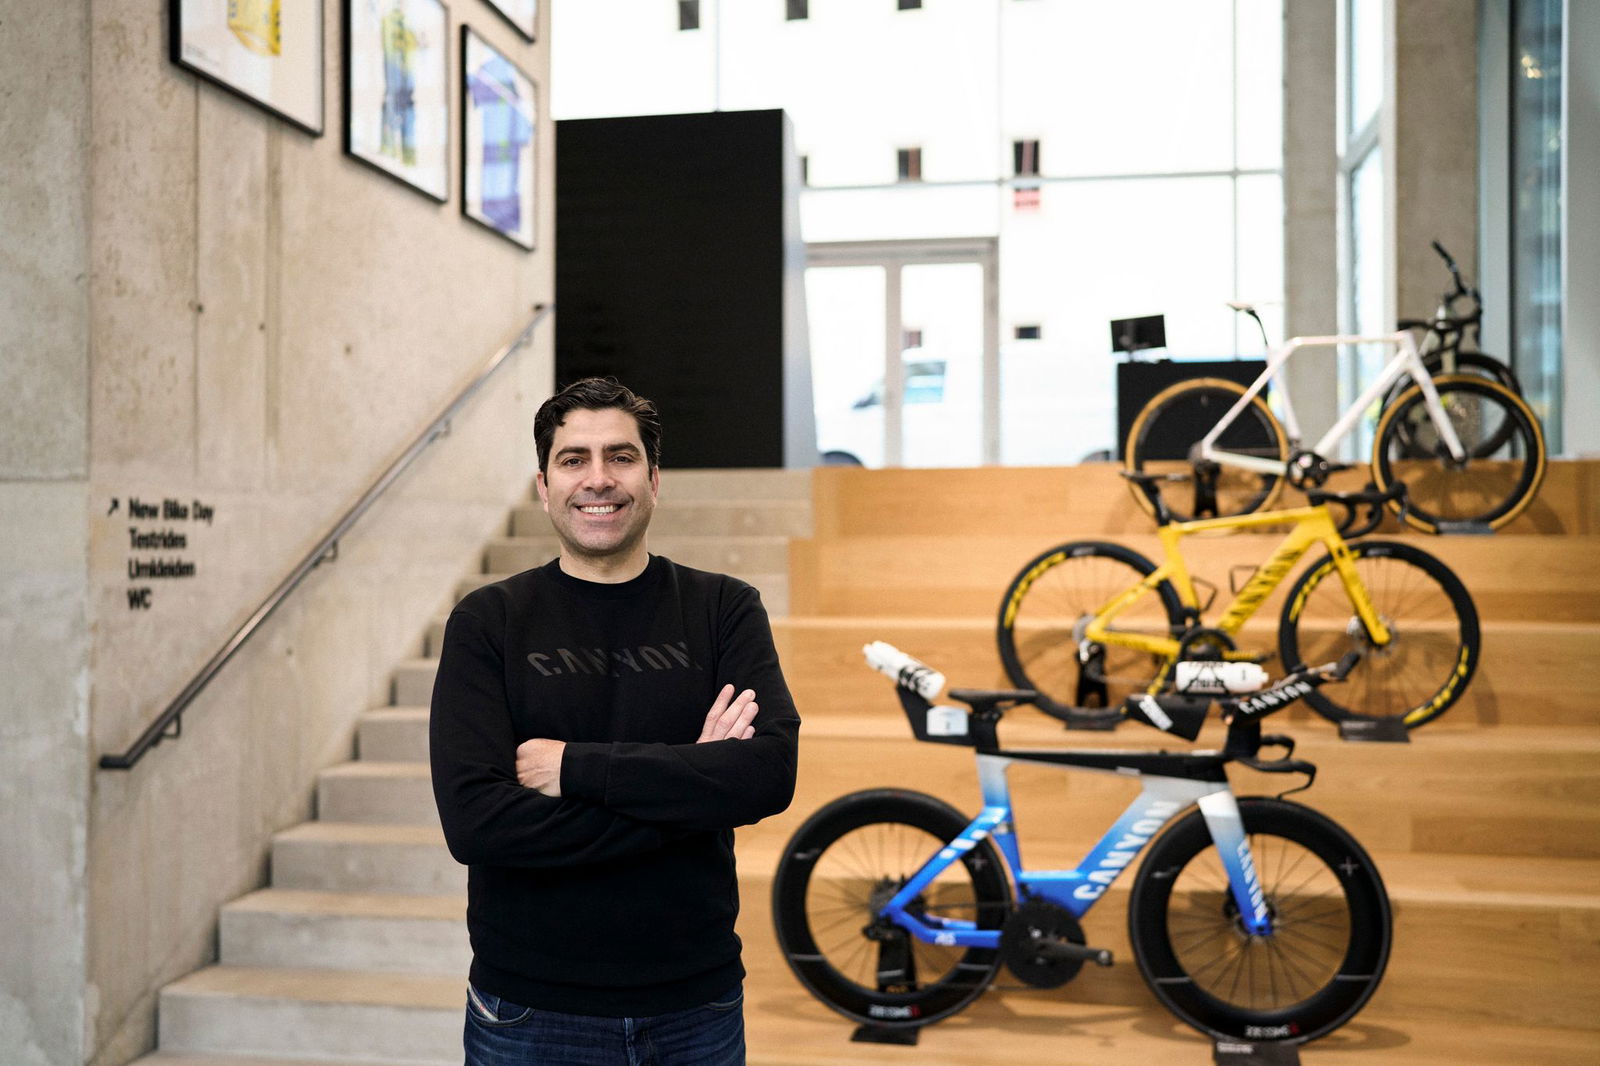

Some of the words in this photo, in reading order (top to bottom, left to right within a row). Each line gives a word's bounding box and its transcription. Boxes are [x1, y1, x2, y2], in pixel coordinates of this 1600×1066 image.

[129, 497, 158, 519] New
[163, 498, 188, 520] Bike
[193, 499, 214, 526] Day
[128, 588, 152, 610] WC
[1238, 681, 1312, 715] CANYON
[1073, 801, 1180, 900] CANYON
